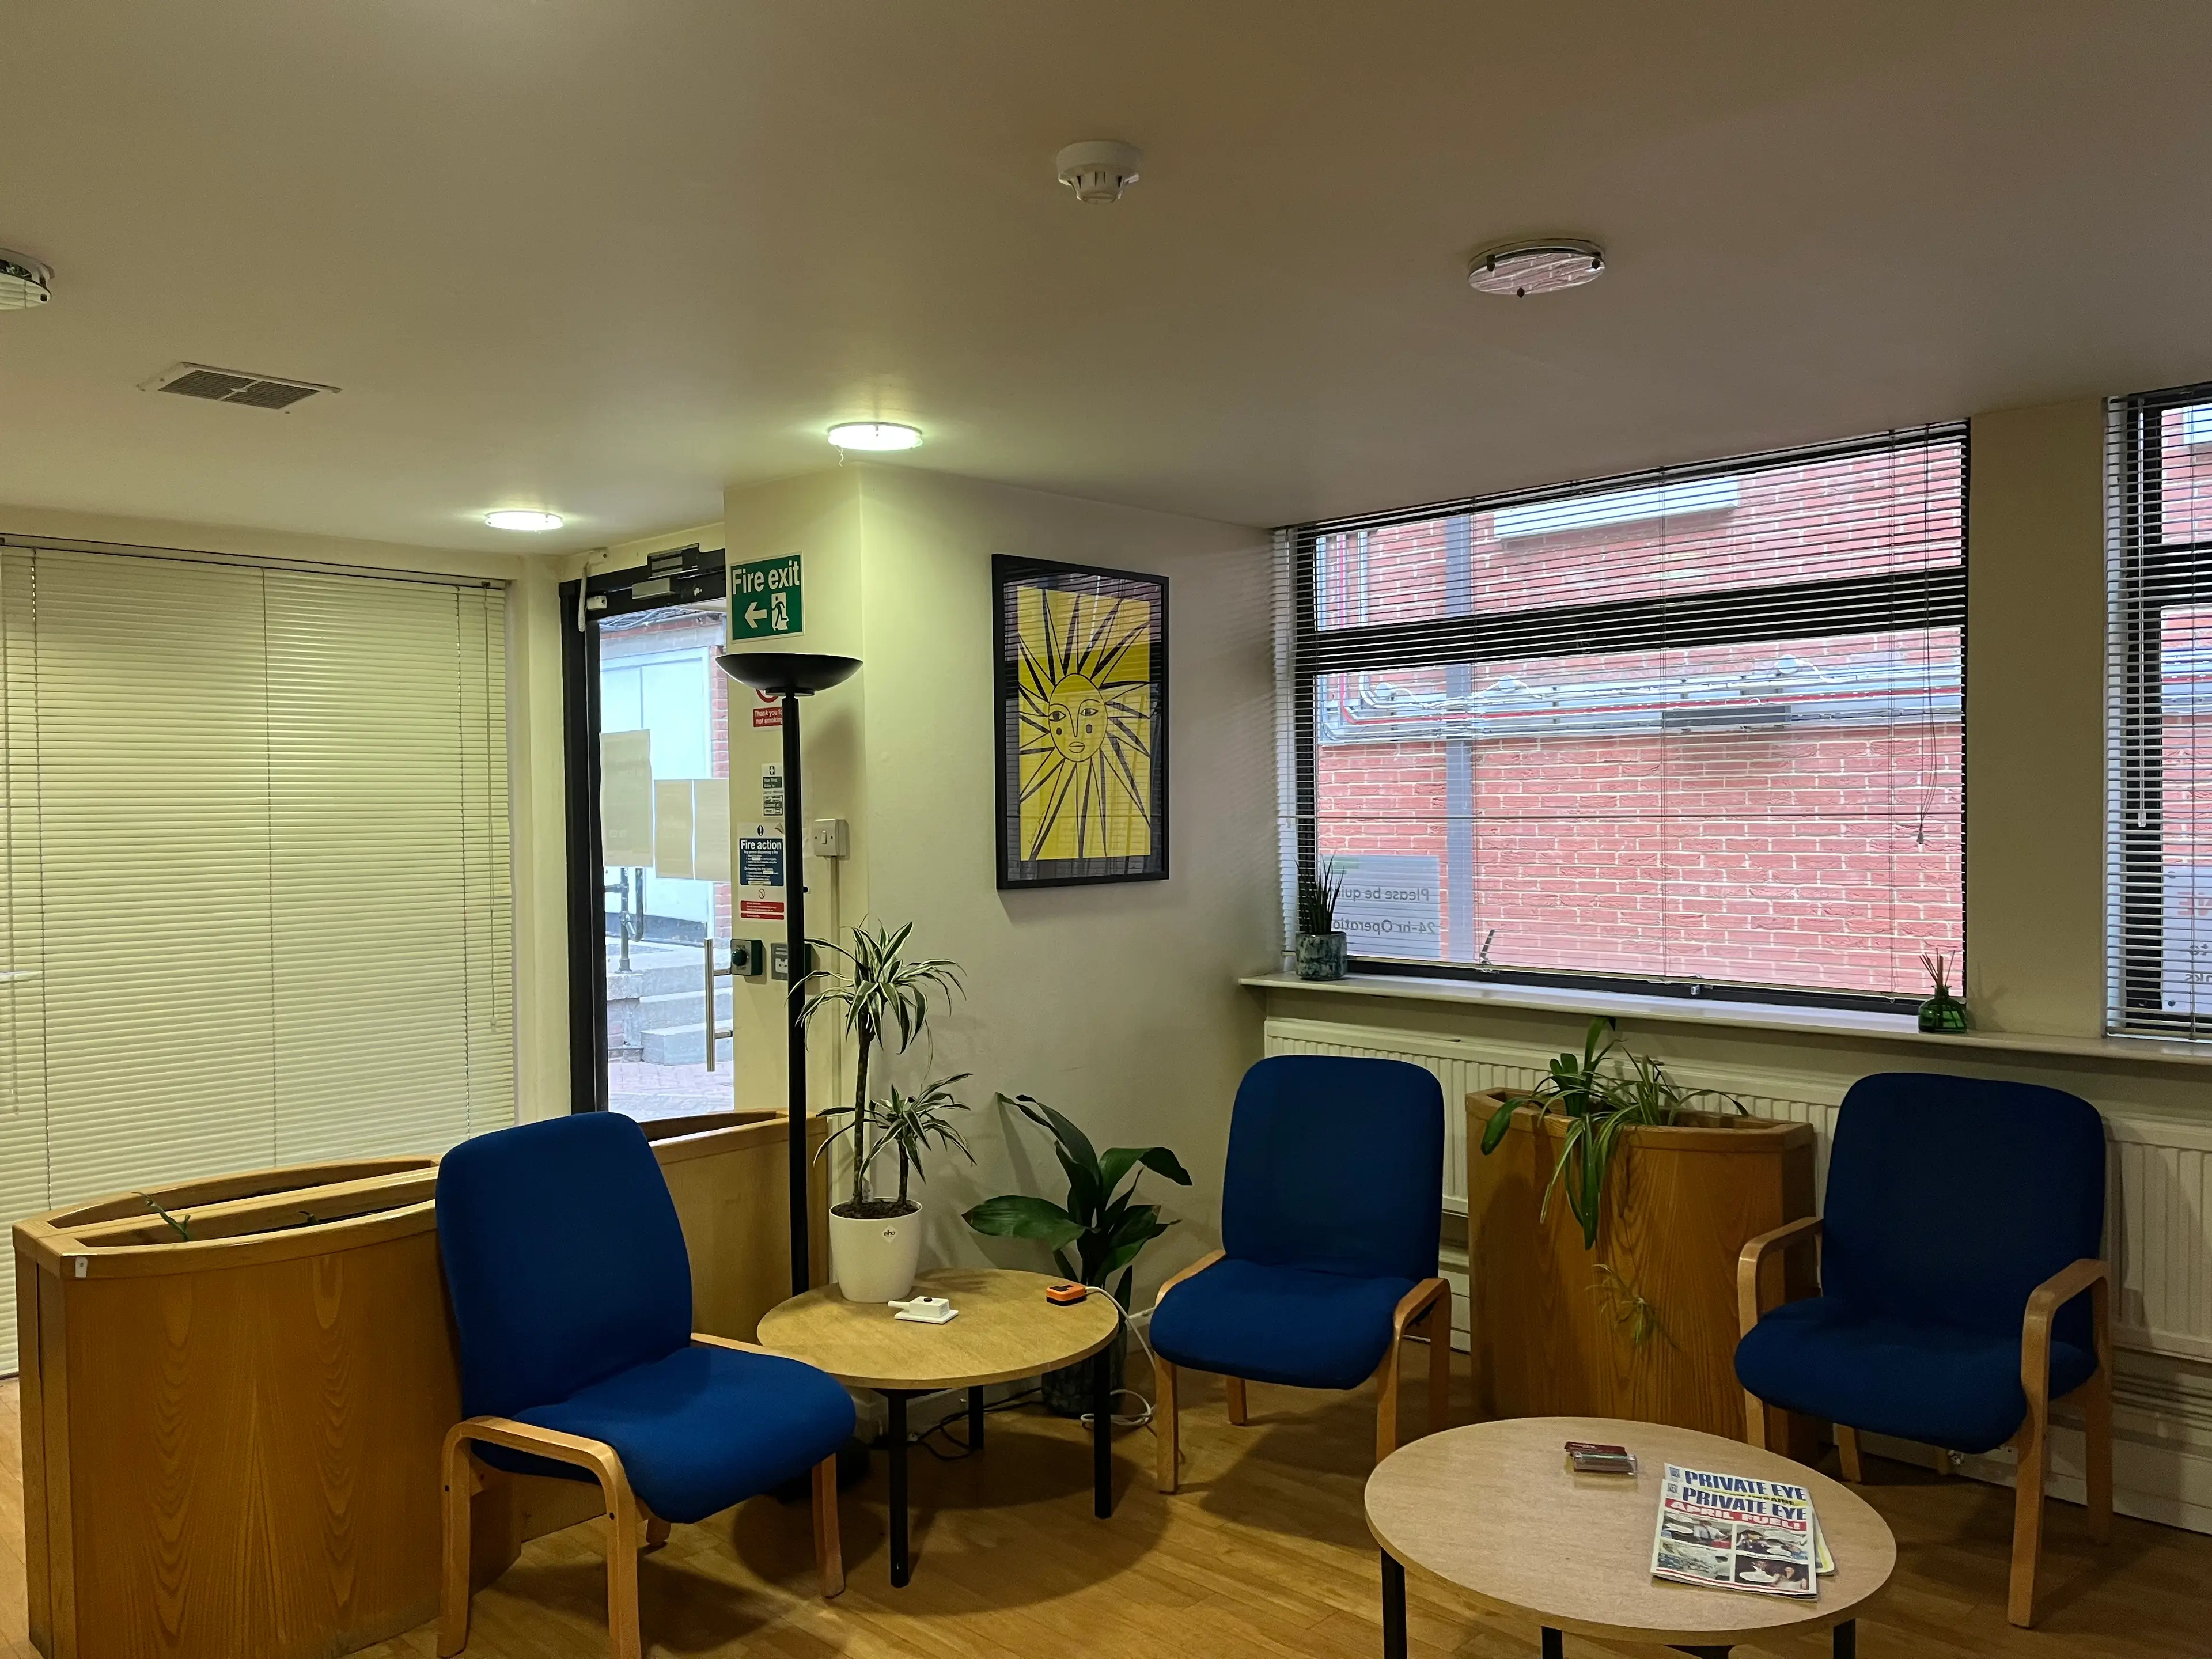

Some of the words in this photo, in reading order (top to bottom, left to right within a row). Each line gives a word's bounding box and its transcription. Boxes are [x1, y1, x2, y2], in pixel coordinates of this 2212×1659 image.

[732, 568, 764, 595] Fire
[768, 560, 800, 590] exit
[768, 710, 778, 718] you
[741, 839, 756, 850] Fire
[757, 840, 782, 850] action
[1684, 1470, 1767, 1495] PRIVATE
[1771, 1483, 1807, 1501] EYE
[1670, 1498, 1734, 1520] APRIL
[1741, 1513, 1800, 1530] FUEL!
[1682, 1487, 1767, 1514] PRIVATE
[1772, 1503, 1807, 1520] EYE
